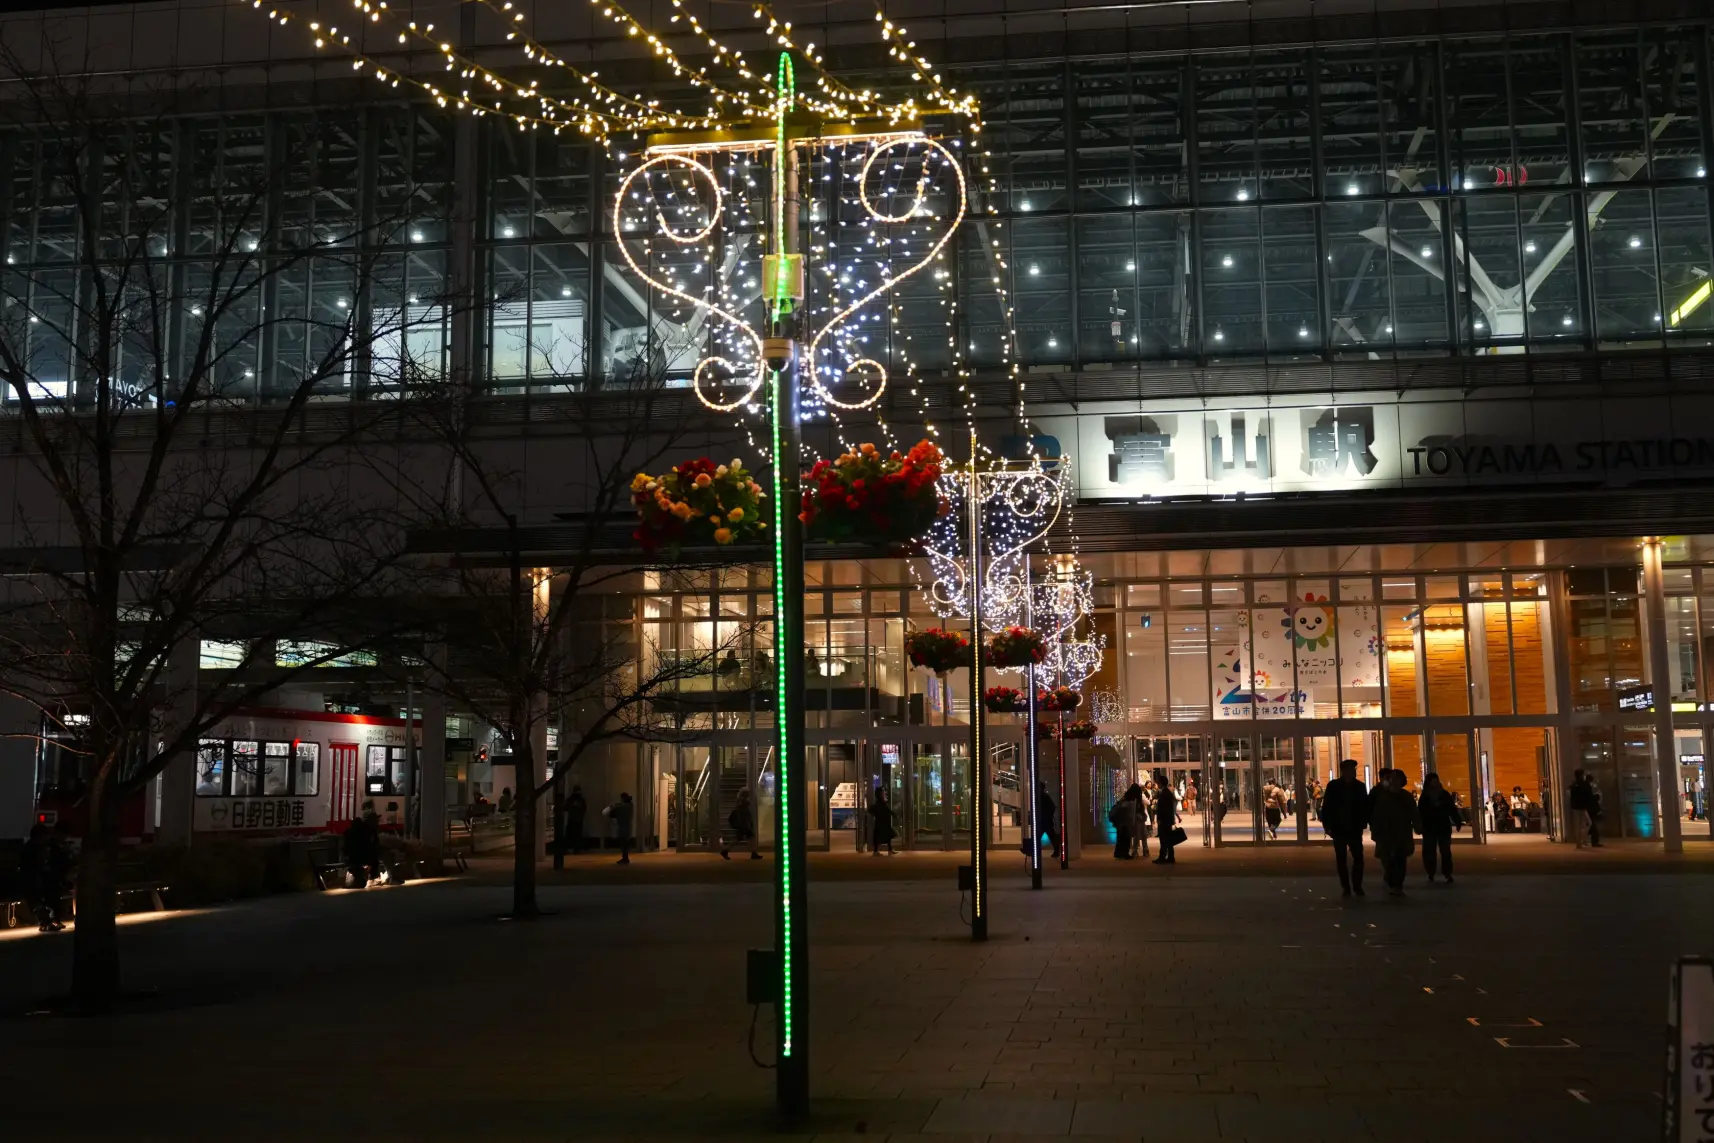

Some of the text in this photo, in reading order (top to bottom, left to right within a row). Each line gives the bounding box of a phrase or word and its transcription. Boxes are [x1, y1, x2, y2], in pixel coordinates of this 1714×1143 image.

[1107, 410, 1374, 485] 富山駅
[1407, 443, 1563, 475] TOYAMA
[232, 799, 305, 828] 日野自動車
